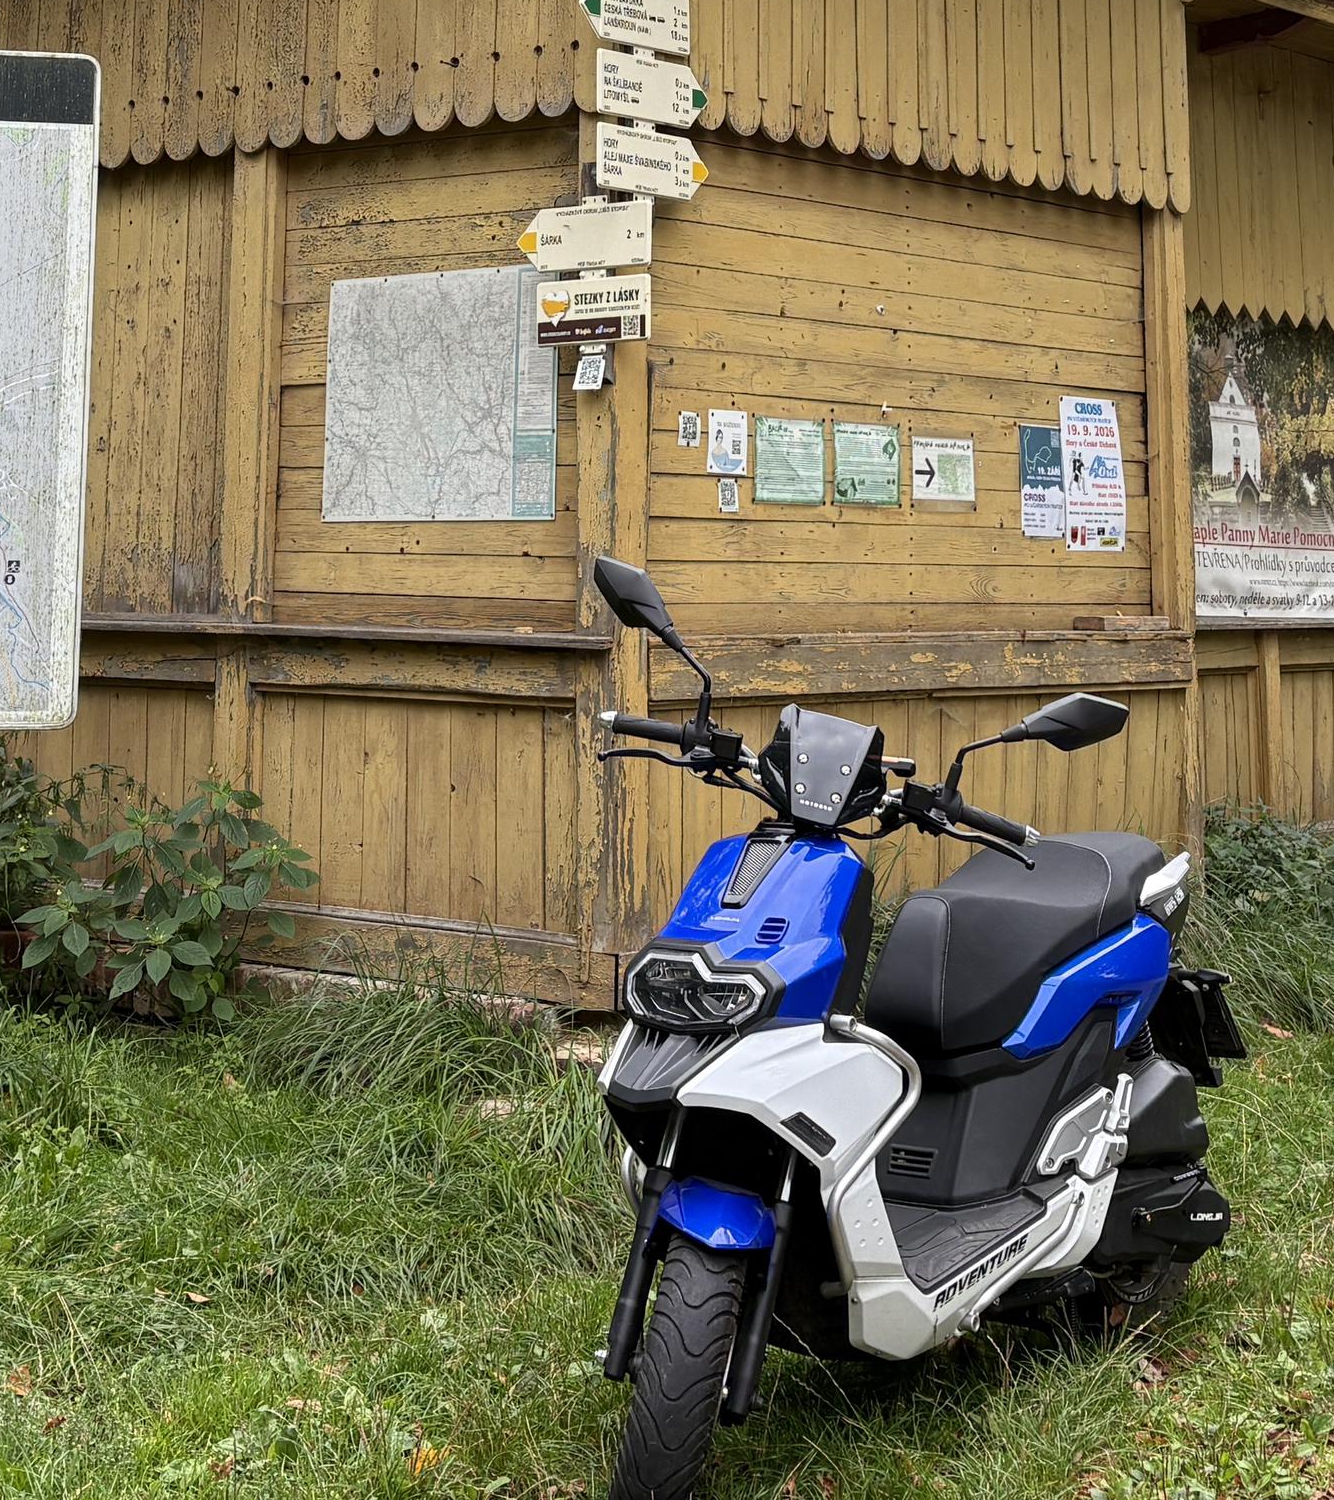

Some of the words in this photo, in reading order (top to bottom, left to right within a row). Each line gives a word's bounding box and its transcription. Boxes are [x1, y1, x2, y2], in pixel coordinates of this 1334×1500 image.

[604, 1, 622, 15] ČESKÁ
[623, 6, 648, 21] TŘEBOVÁ
[673, 18, 678, 28] 2
[604, 63, 619, 74] HORY
[604, 89, 630, 103] LITOMYŠL
[672, 102, 679, 113] 12
[604, 138, 619, 149] HORY
[603, 150, 617, 162] ALEJ
[540, 234, 563, 246] ŠÁRKA
[627, 229, 631, 239] 2
[574, 292, 604, 306] STEZKY
[607, 291, 610, 302] Z
[613, 286, 640, 302] LÁSKY
[1075, 402, 1103, 416] CROSS
[1067, 424, 1081, 436] 19.
[1083, 425, 1092, 436] 9.
[1023, 493, 1046, 503] CROSS
[1195, 520, 1218, 547] aple
[1221, 522, 1256, 550] Panny
[1259, 524, 1291, 545] Marie
[1197, 547, 1286, 578] TEVŘENA/Prohlídky
[1289, 561, 1293, 572] s
[1210, 590, 1238, 608] soboty,
[1239, 591, 1266, 606] neděle
[1266, 596, 1271, 604] a
[1271, 592, 1295, 610] svátky
[1313, 597, 1317, 605] a
[933, 1233, 1029, 1313] ADVENTURE
